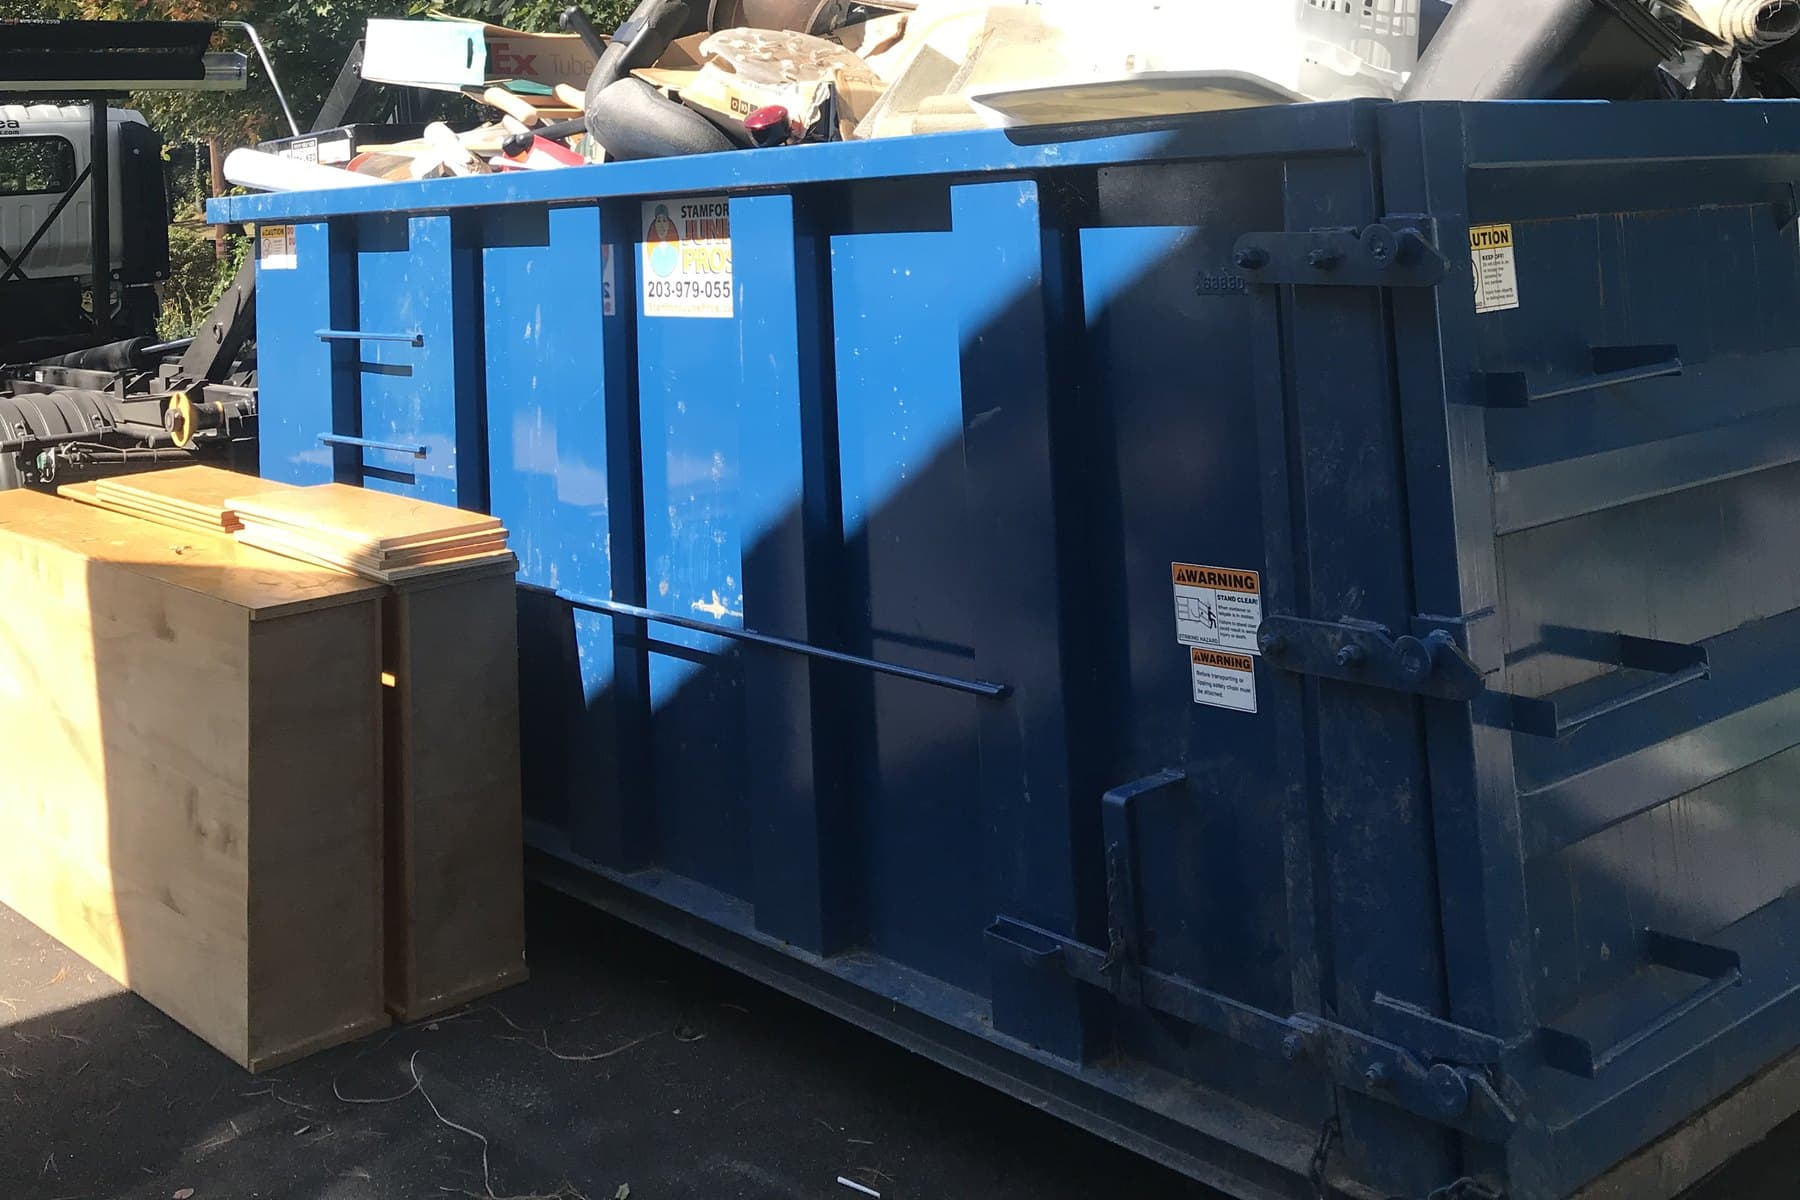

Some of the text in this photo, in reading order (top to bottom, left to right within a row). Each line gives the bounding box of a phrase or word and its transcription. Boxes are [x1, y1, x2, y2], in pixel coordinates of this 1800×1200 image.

[549, 53, 594, 75] Tube
[0, 119, 20, 129] ea
[681, 203, 730, 218] STAMFOR
[1471, 229, 1509, 246] UTION
[648, 281, 731, 298] 203-979-055
[1185, 569, 1255, 590] WARNING
[1217, 594, 1236, 602] STAND
[1200, 652, 1251, 669] WARNING
[1196, 670, 1210, 678] Before
[1211, 673, 1239, 683] transporting
